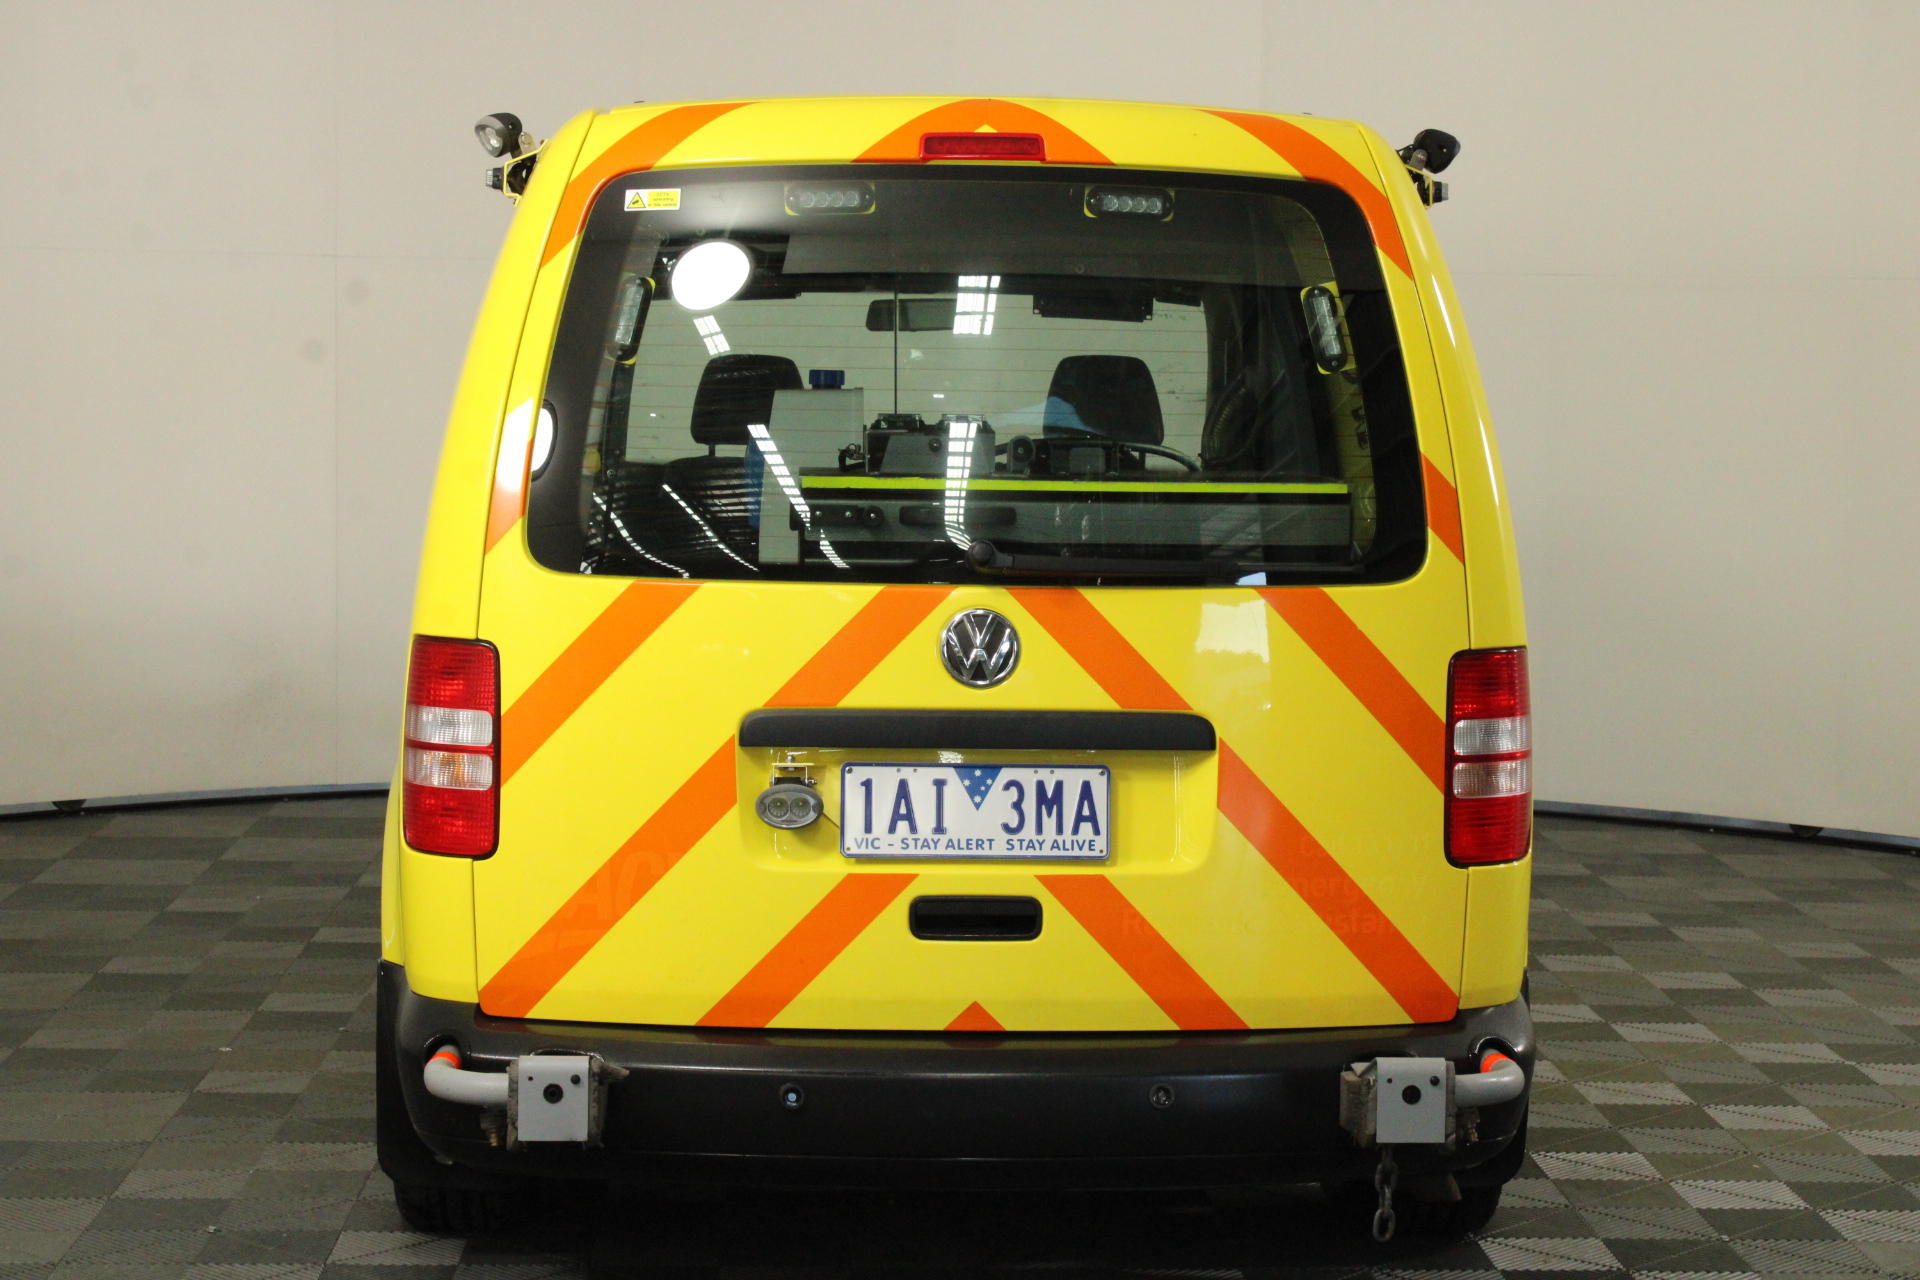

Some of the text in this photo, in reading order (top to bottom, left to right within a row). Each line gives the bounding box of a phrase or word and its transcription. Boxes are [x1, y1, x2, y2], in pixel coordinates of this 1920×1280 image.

[860, 778, 1101, 836] 1AI 3MA
[854, 837, 880, 850] VIC
[900, 838, 941, 850] STAY
[944, 838, 995, 851] ALERT
[1006, 838, 1046, 851] STAY
[1050, 839, 1096, 852] ALIVE
